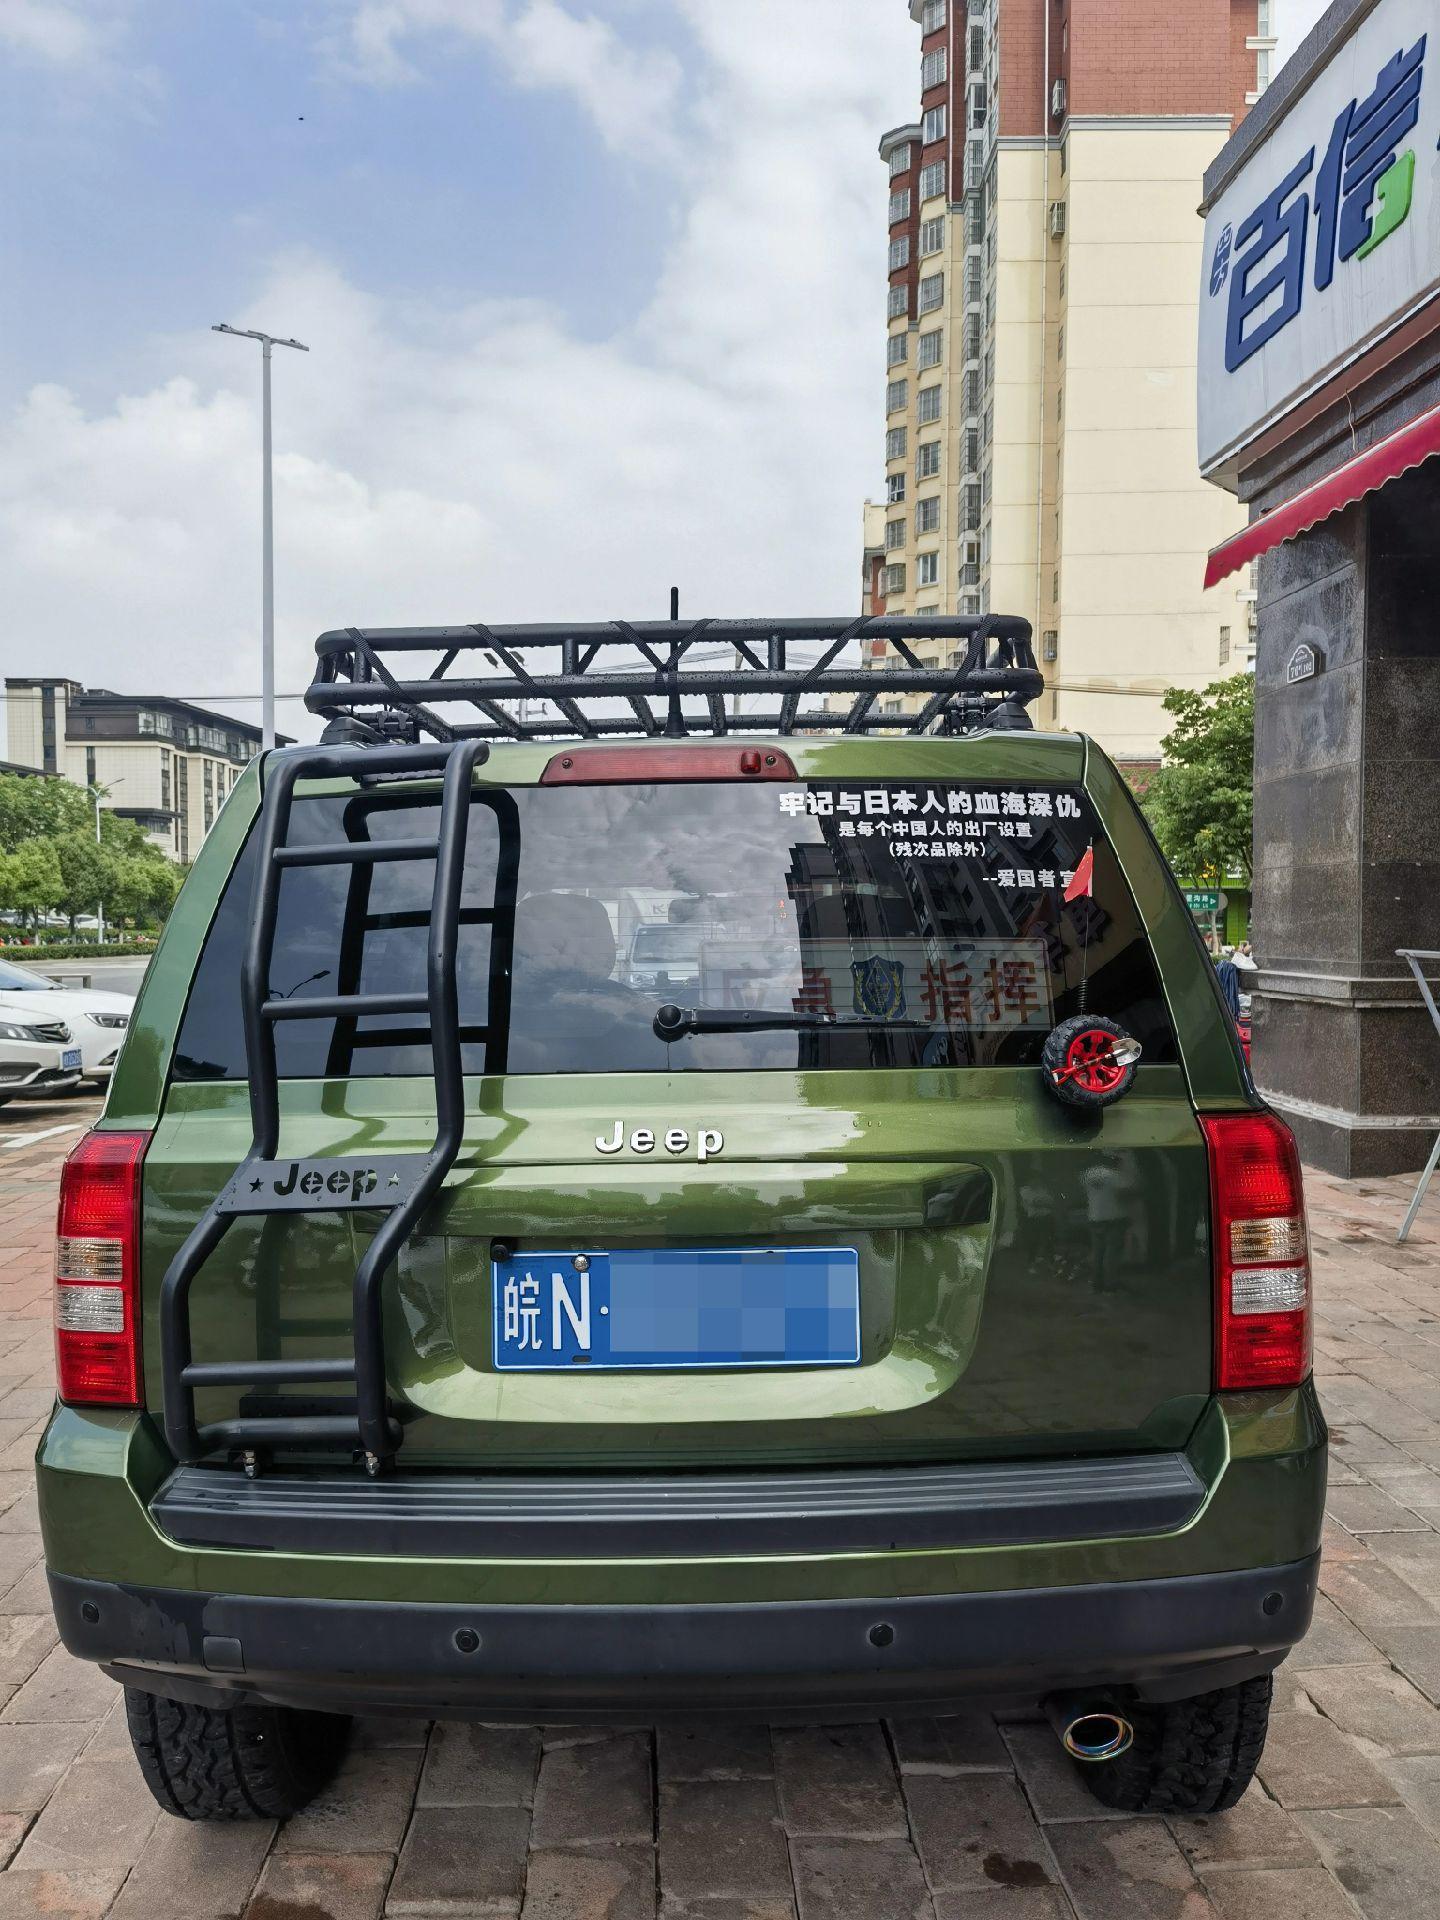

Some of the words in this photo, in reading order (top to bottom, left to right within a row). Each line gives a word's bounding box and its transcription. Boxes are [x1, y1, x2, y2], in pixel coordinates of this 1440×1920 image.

[1225, 33, 1427, 373] 百信
[779, 790, 1081, 818] 牢记与日本人的血海深仇
[839, 820, 1033, 838] 是每个中国人的出厂设置
[889, 841, 986, 858] (残次品除外)
[595, 1120, 725, 1162] Jeep
[273, 1163, 378, 1202] Jeep
